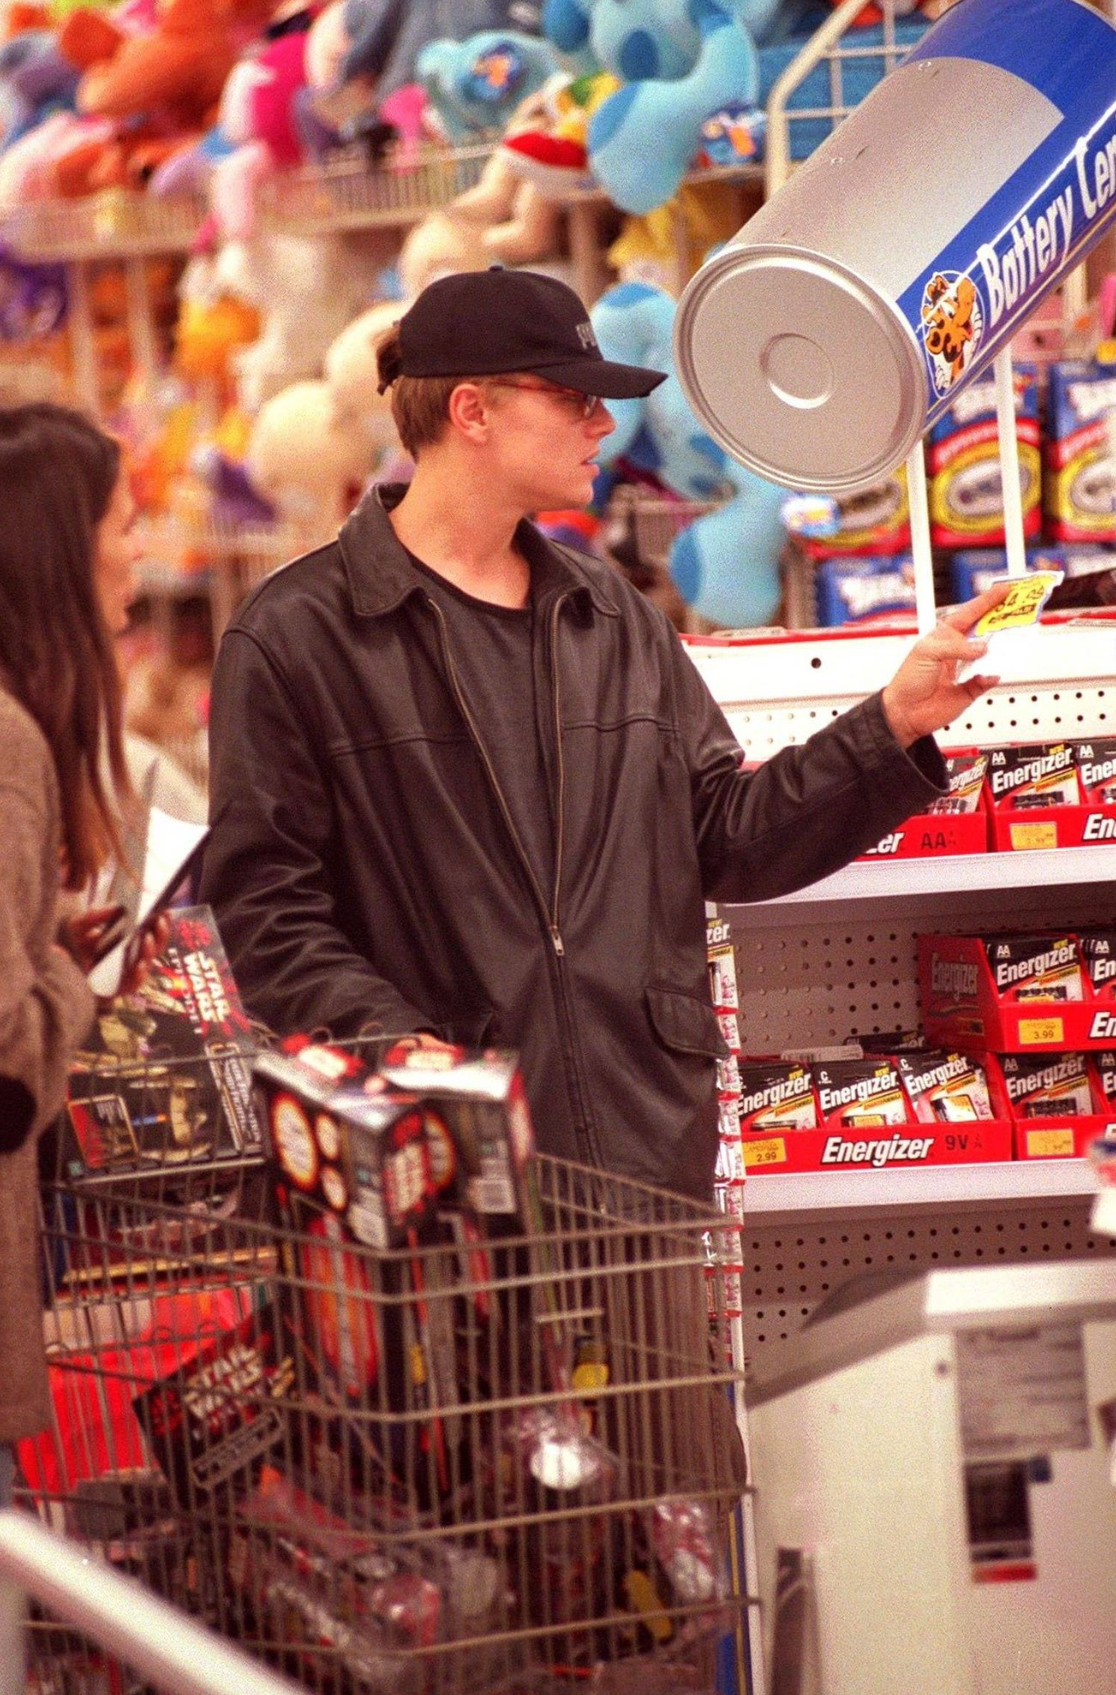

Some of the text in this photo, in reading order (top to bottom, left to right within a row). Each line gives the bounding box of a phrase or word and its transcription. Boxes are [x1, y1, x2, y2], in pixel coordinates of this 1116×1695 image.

[977, 243, 1073, 328] Battery
[992, 752, 1006, 765] AA
[1080, 745, 1094, 757] AA
[992, 748, 1073, 794] Energizer
[921, 832, 947, 850] AA
[997, 945, 1010, 958] AA
[1095, 940, 1109, 953] AA
[932, 953, 978, 1002] Energizer
[997, 944, 1076, 987] Energizer
[184, 952, 218, 1022] WARS
[198, 950, 231, 1022] STAR
[1033, 1029, 1055, 1041] 3.99
[904, 1057, 968, 1097] Energizer
[1004, 1058, 1018, 1072] AA
[1006, 1055, 1084, 1099] Energizer
[820, 1071, 898, 1111] Energizer
[757, 1151, 777, 1162] 2.99
[822, 1134, 968, 1167] Energizer 9V
